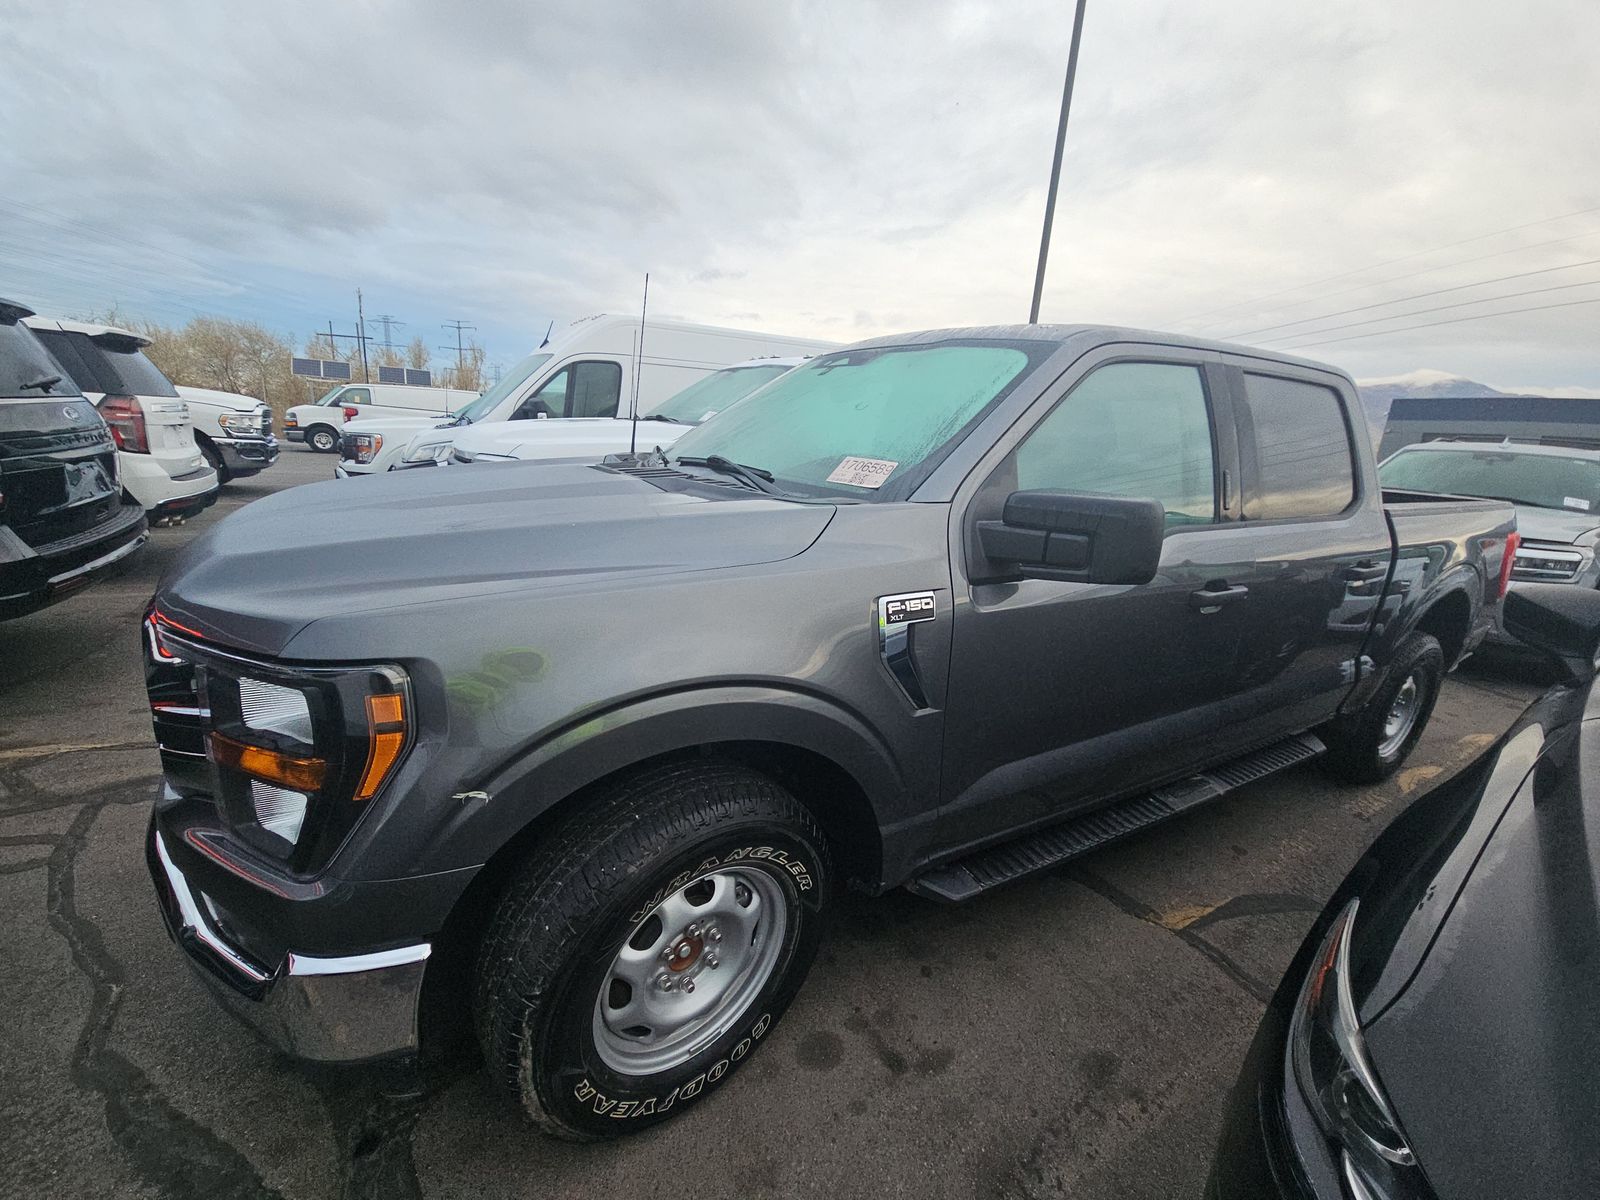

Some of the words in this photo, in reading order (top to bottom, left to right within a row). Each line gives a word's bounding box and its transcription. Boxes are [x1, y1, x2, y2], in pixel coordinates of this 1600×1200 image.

[887, 598, 934, 614] F-150
[890, 614, 905, 622] XLT
[629, 846, 813, 923] WRANGLER
[573, 1013, 771, 1119] GOODYEAR
